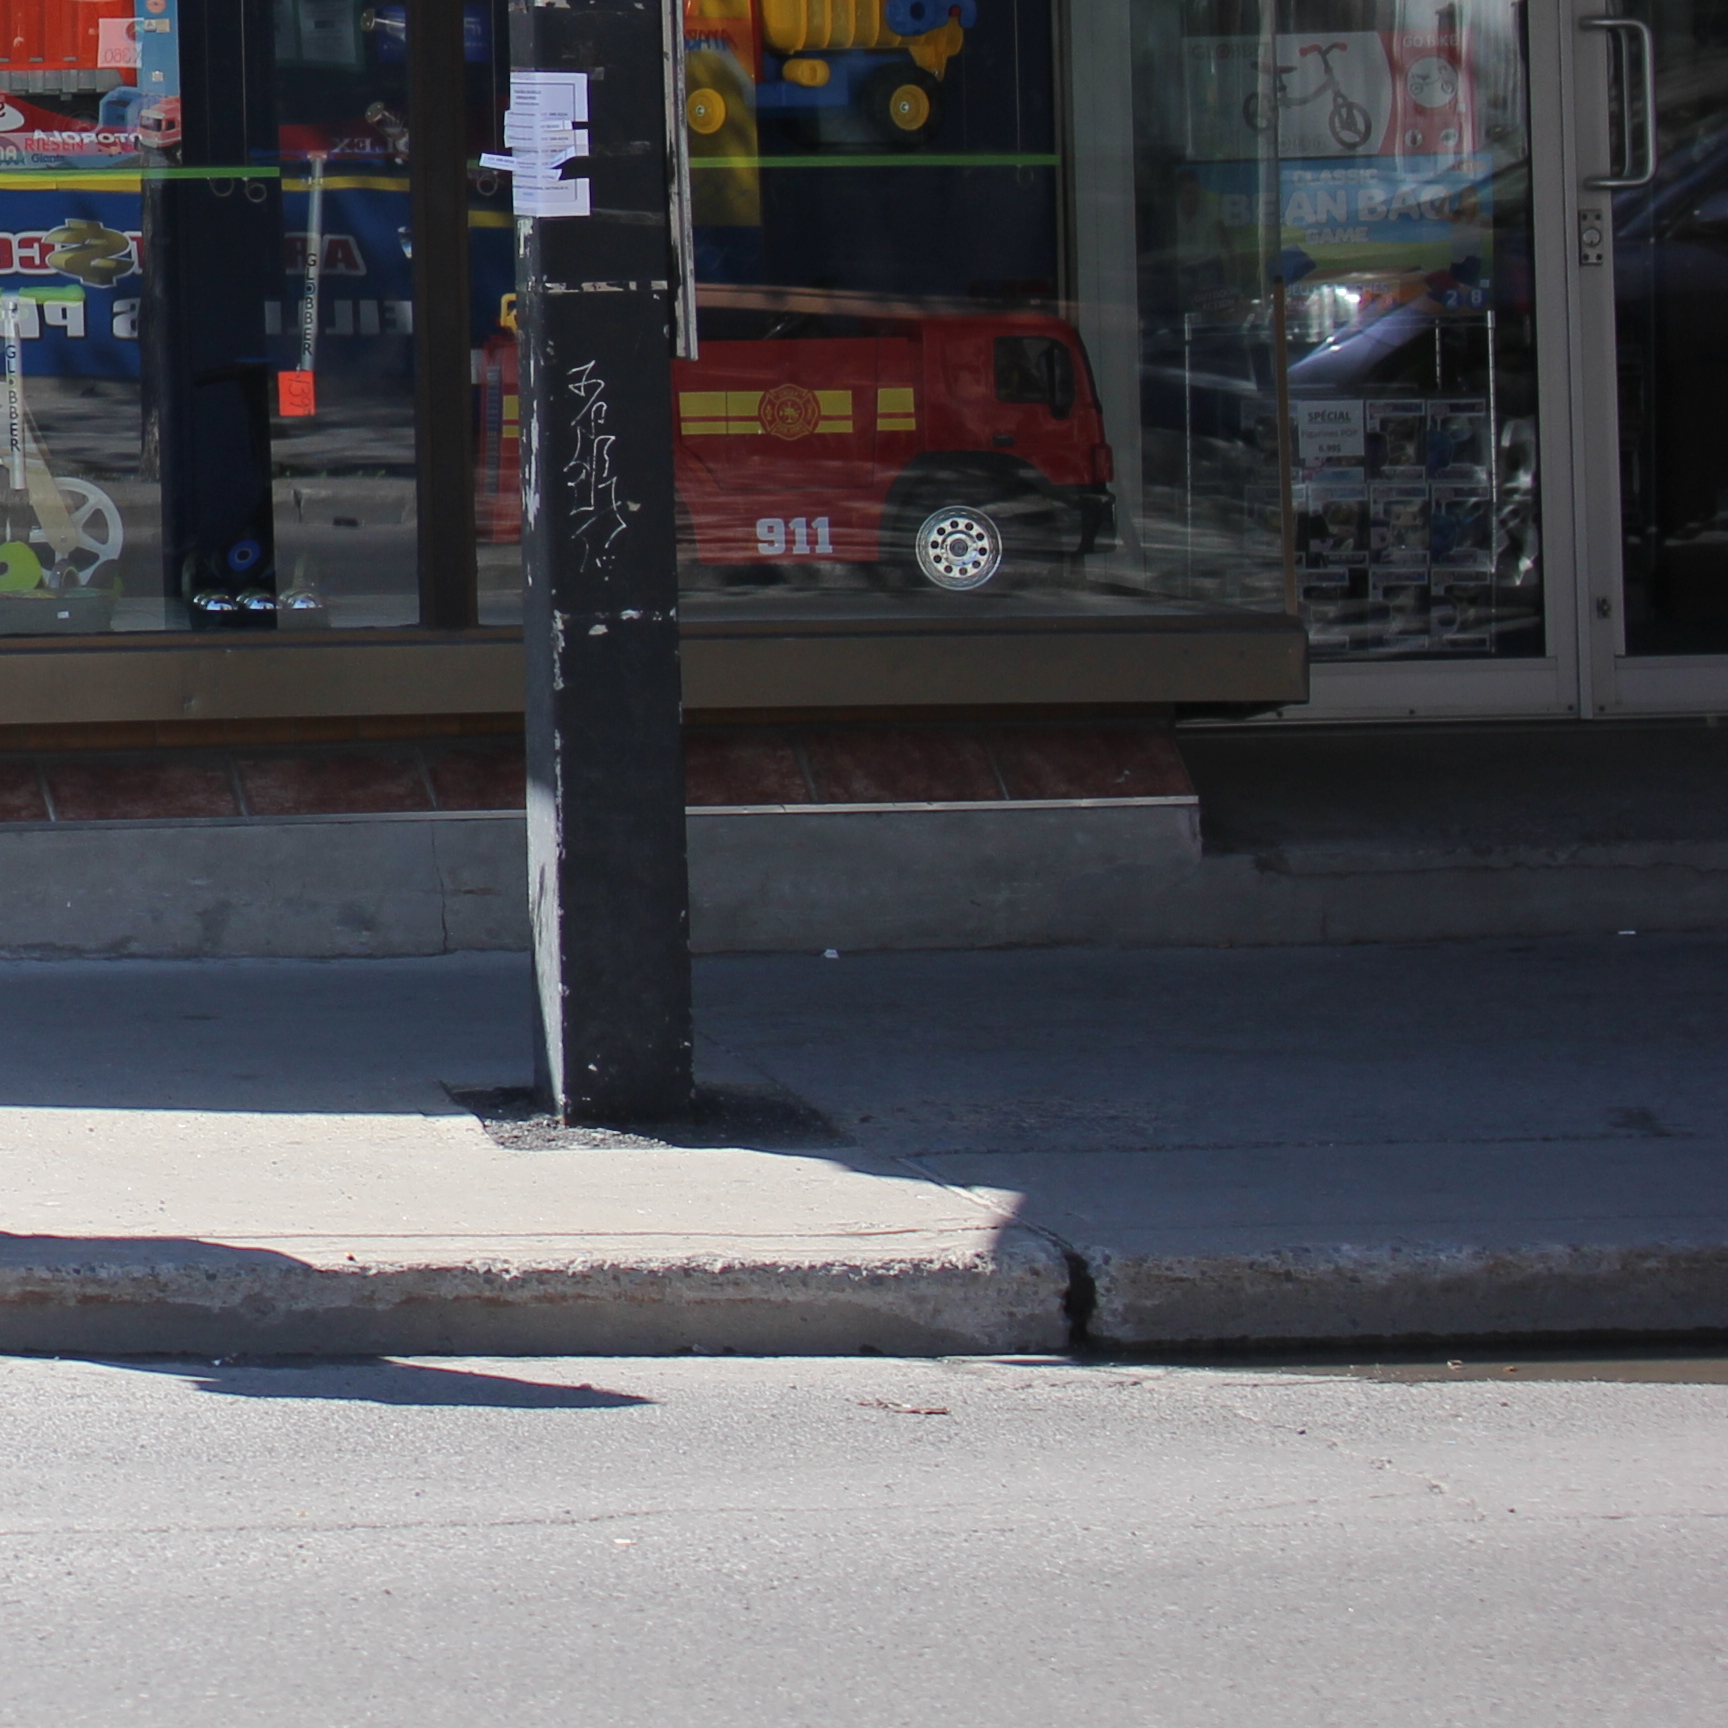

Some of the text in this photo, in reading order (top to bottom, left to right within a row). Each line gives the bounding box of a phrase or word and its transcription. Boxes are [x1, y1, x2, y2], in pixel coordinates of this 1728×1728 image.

[24, 137, 84, 152] RIESEN
[6, 344, 21, 453] GLOBBER
[1307, 409, 1352, 423] SPÉCIAL
[756, 516, 834, 555] 911
